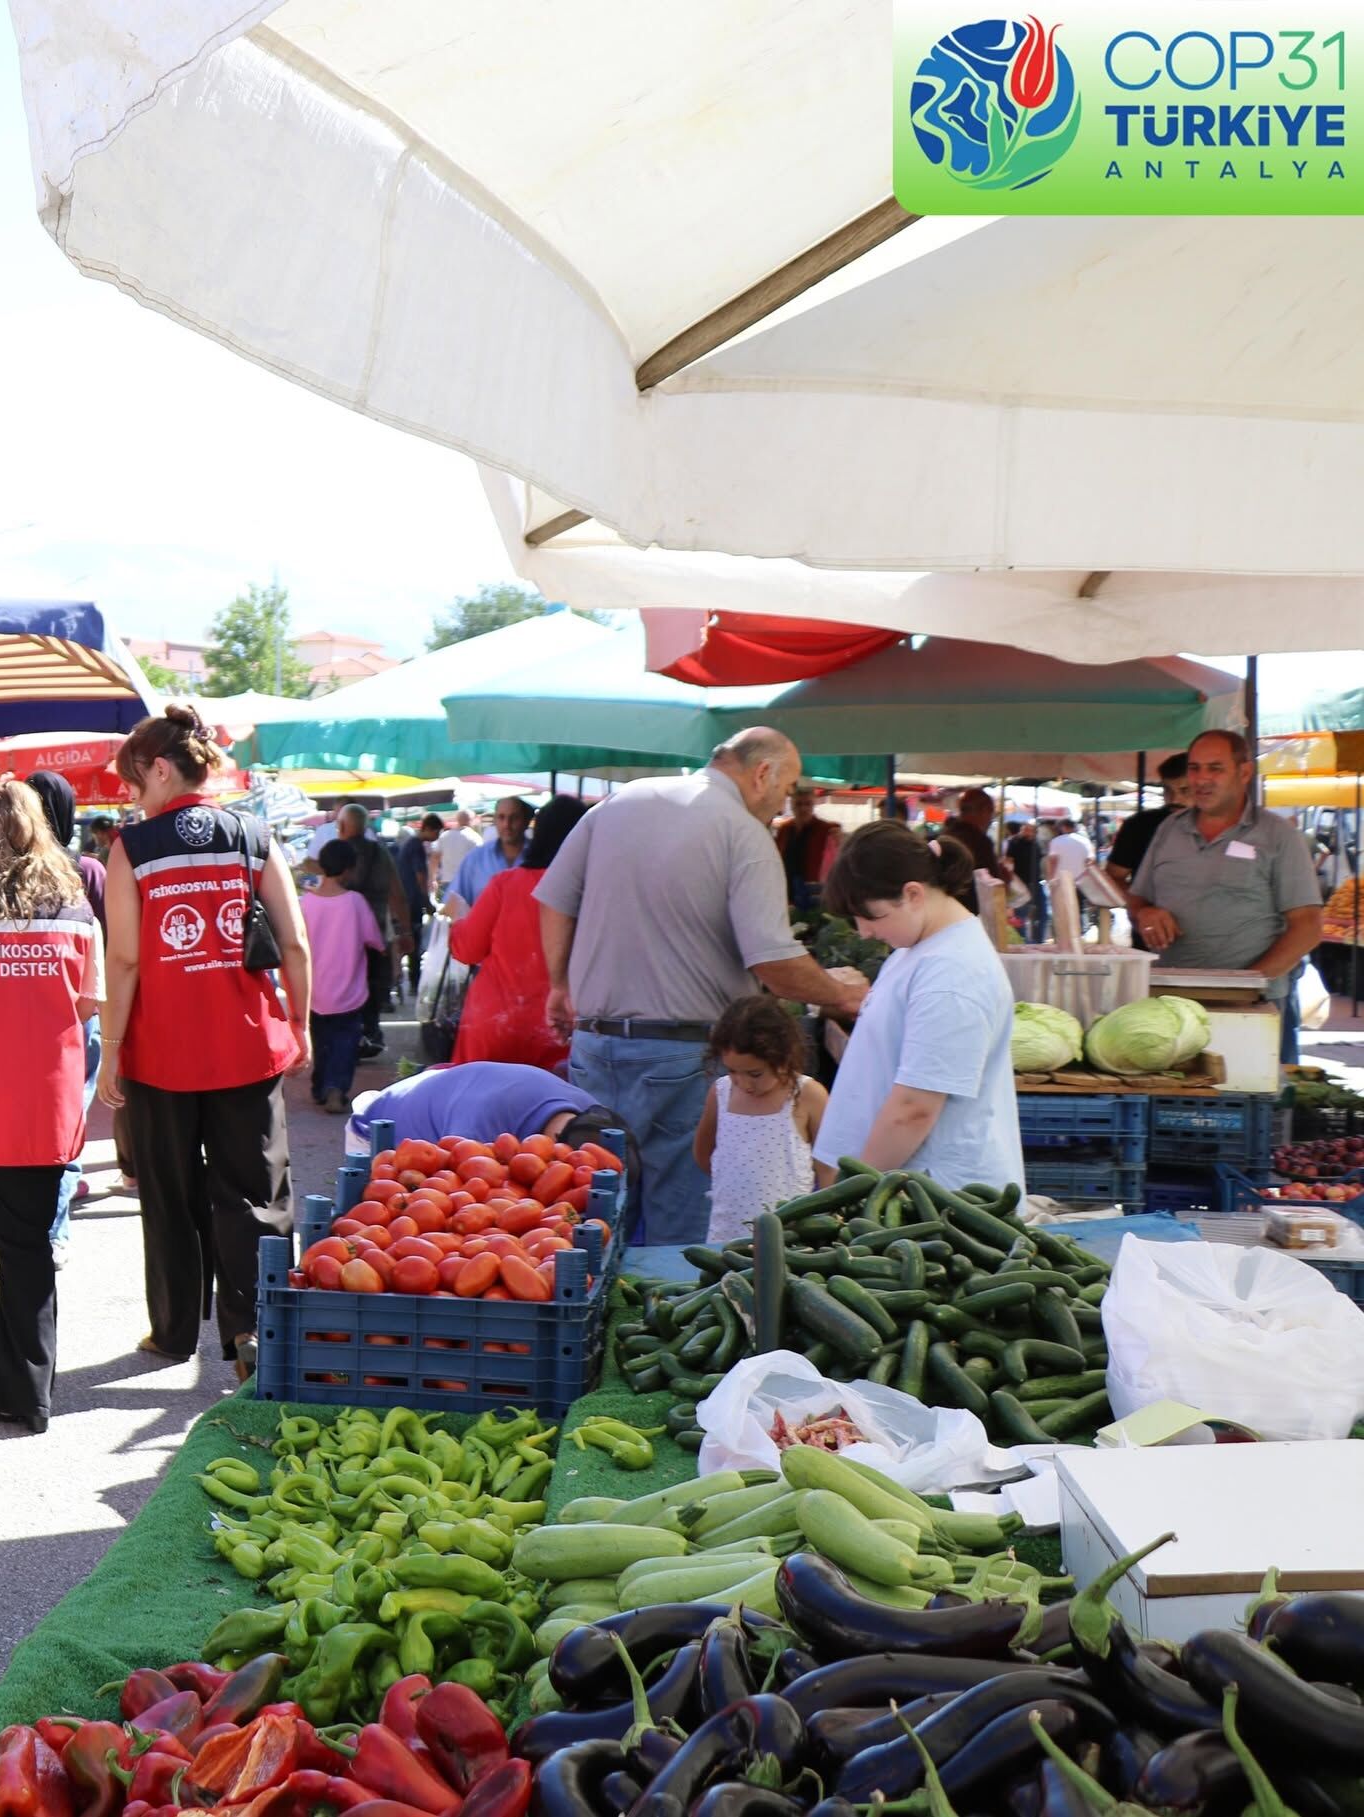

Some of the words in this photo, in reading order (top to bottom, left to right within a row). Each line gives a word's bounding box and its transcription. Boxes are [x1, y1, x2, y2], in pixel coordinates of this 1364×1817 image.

[149, 884, 220, 899] PSİKOSOSYAL
[171, 914, 186, 925] ALO
[227, 907, 242, 919] ALO
[167, 924, 197, 940] 183
[0, 962, 60, 977] DESTEK
